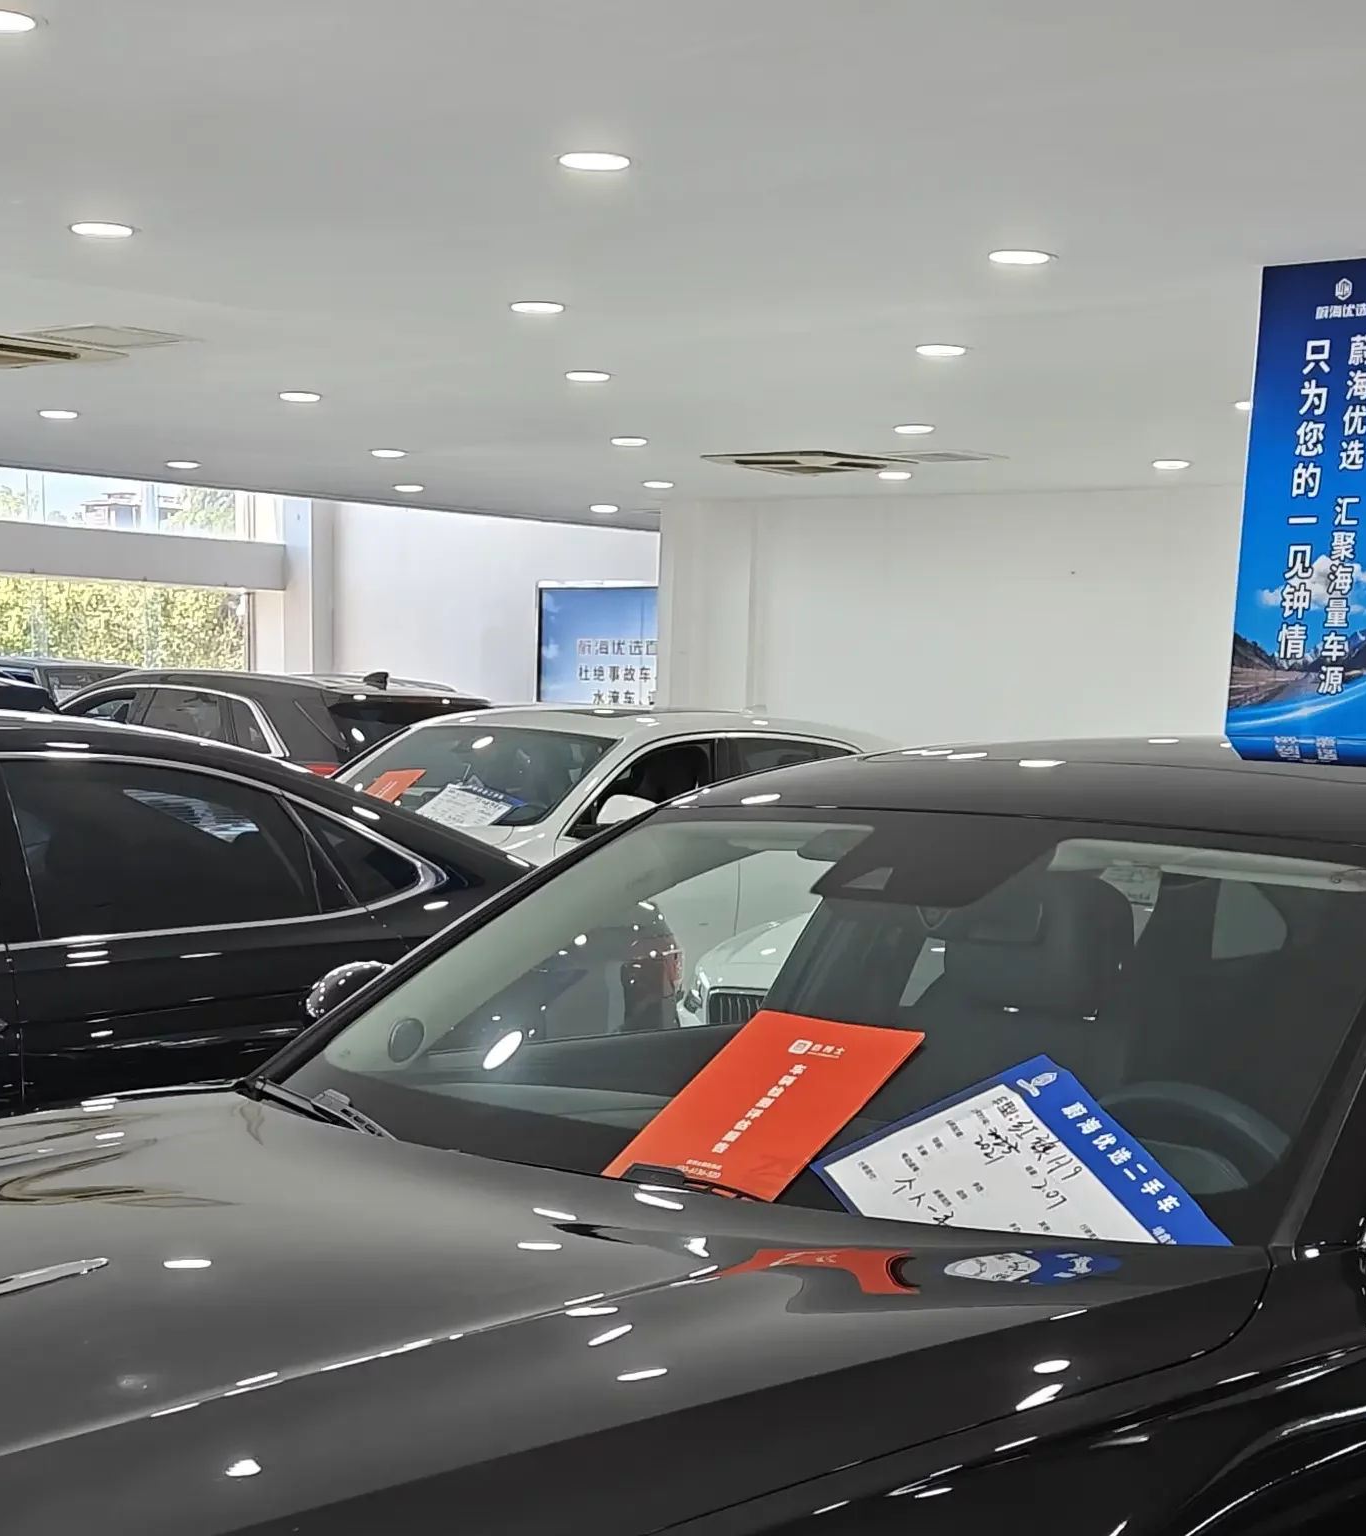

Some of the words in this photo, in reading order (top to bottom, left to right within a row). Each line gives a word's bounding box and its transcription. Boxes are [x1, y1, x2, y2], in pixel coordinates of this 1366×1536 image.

[1277, 338, 1331, 660] 只为您的一见钟情
[1317, 495, 1360, 695] 汇聚海量车源
[1061, 1101, 1181, 1214] 蔚海优选二手车
